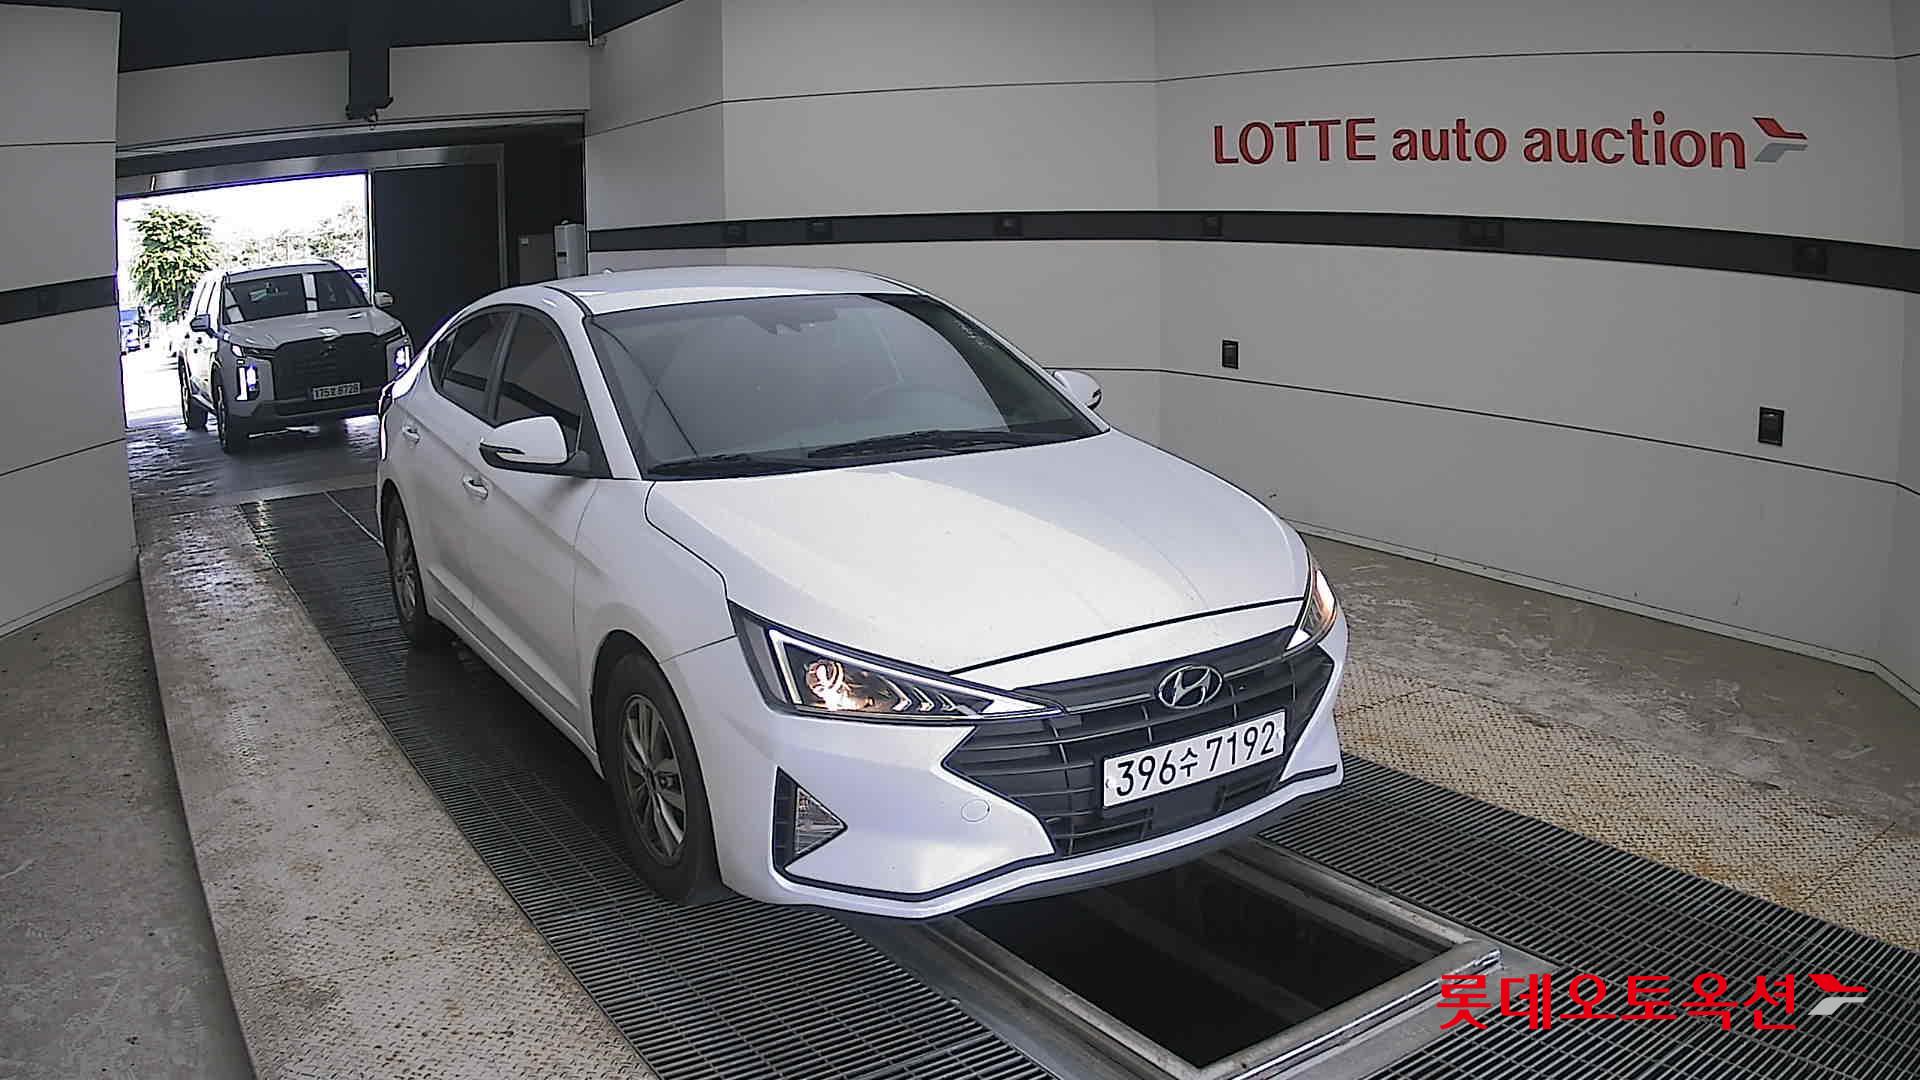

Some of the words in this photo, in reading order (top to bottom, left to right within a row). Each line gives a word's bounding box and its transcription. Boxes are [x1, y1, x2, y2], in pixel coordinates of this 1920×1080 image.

[1214, 118, 1376, 165] LOTTE
[1392, 118, 1507, 163] auto
[1523, 111, 1746, 169] auction
[1206, 721, 1274, 772] 7192
